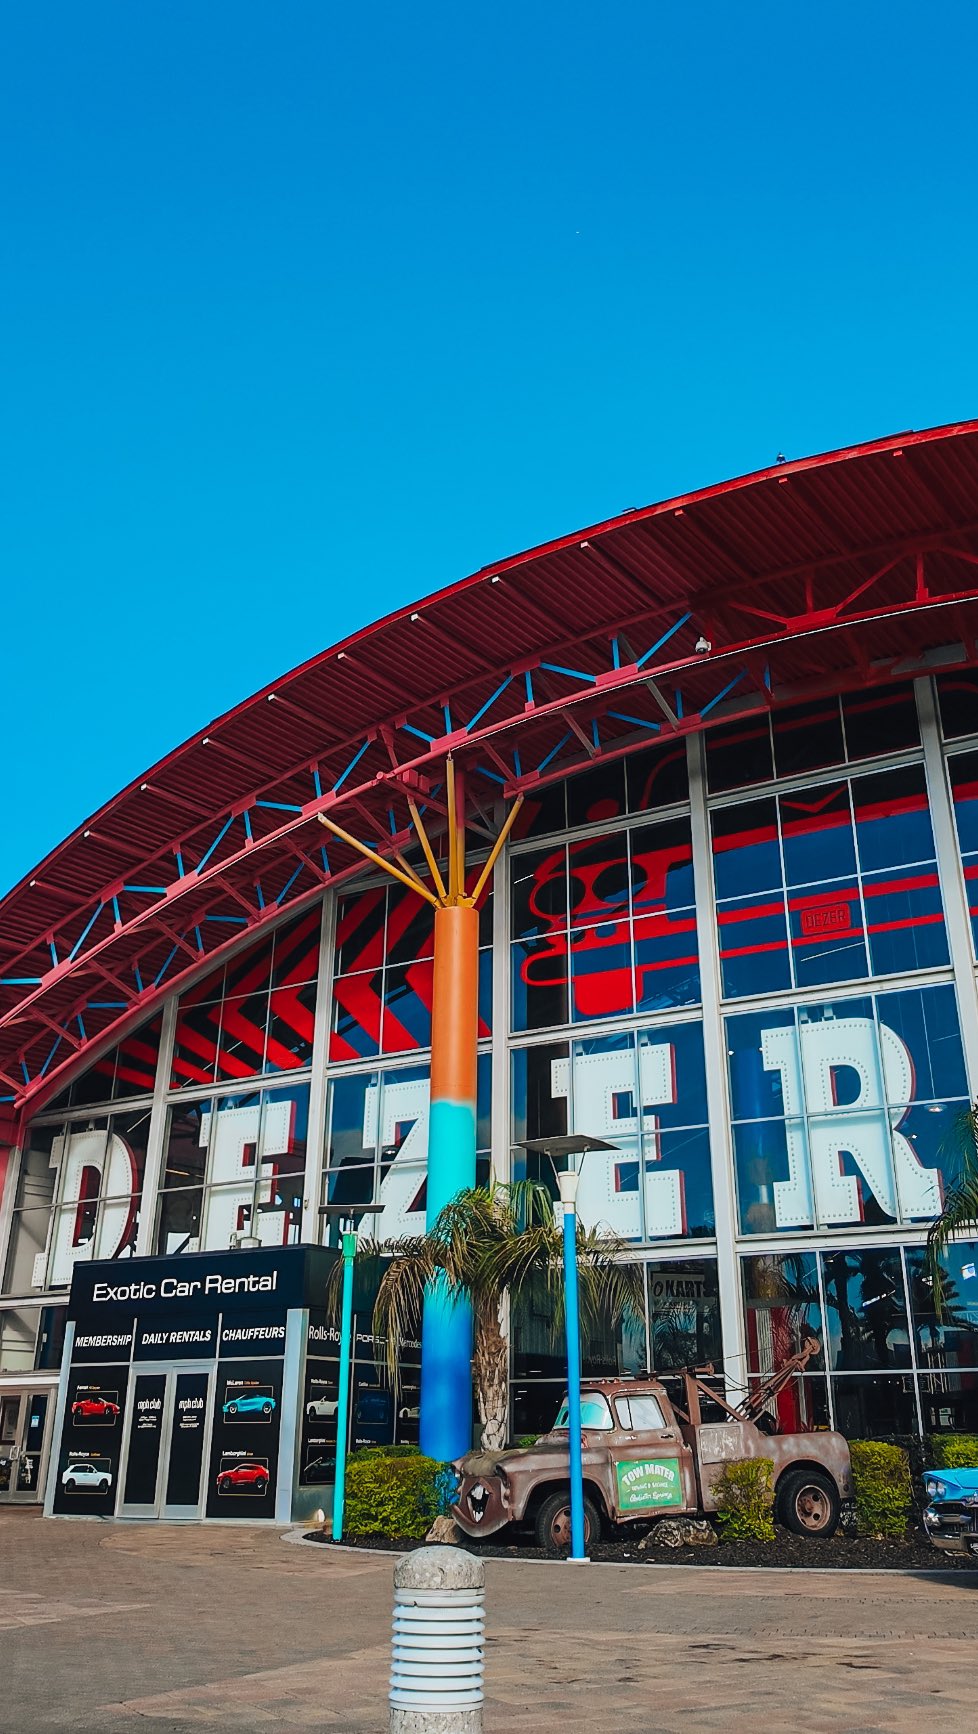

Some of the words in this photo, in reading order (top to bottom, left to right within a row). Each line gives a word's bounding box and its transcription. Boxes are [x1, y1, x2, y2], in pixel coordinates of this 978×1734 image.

[806, 909, 845, 928] DEZER
[92, 1281, 156, 1302] Exotic
[160, 1278, 201, 1298] Car
[204, 1270, 278, 1295] Rental
[666, 1279, 714, 1298] KARTS
[75, 1334, 132, 1347] MEMBERSHIP
[141, 1332, 169, 1345] DAILY
[169, 1329, 212, 1344] RENTALS
[222, 1326, 285, 1341] CHAUFFEURS
[621, 1465, 644, 1486] TOW
[644, 1463, 675, 1482] MATER
